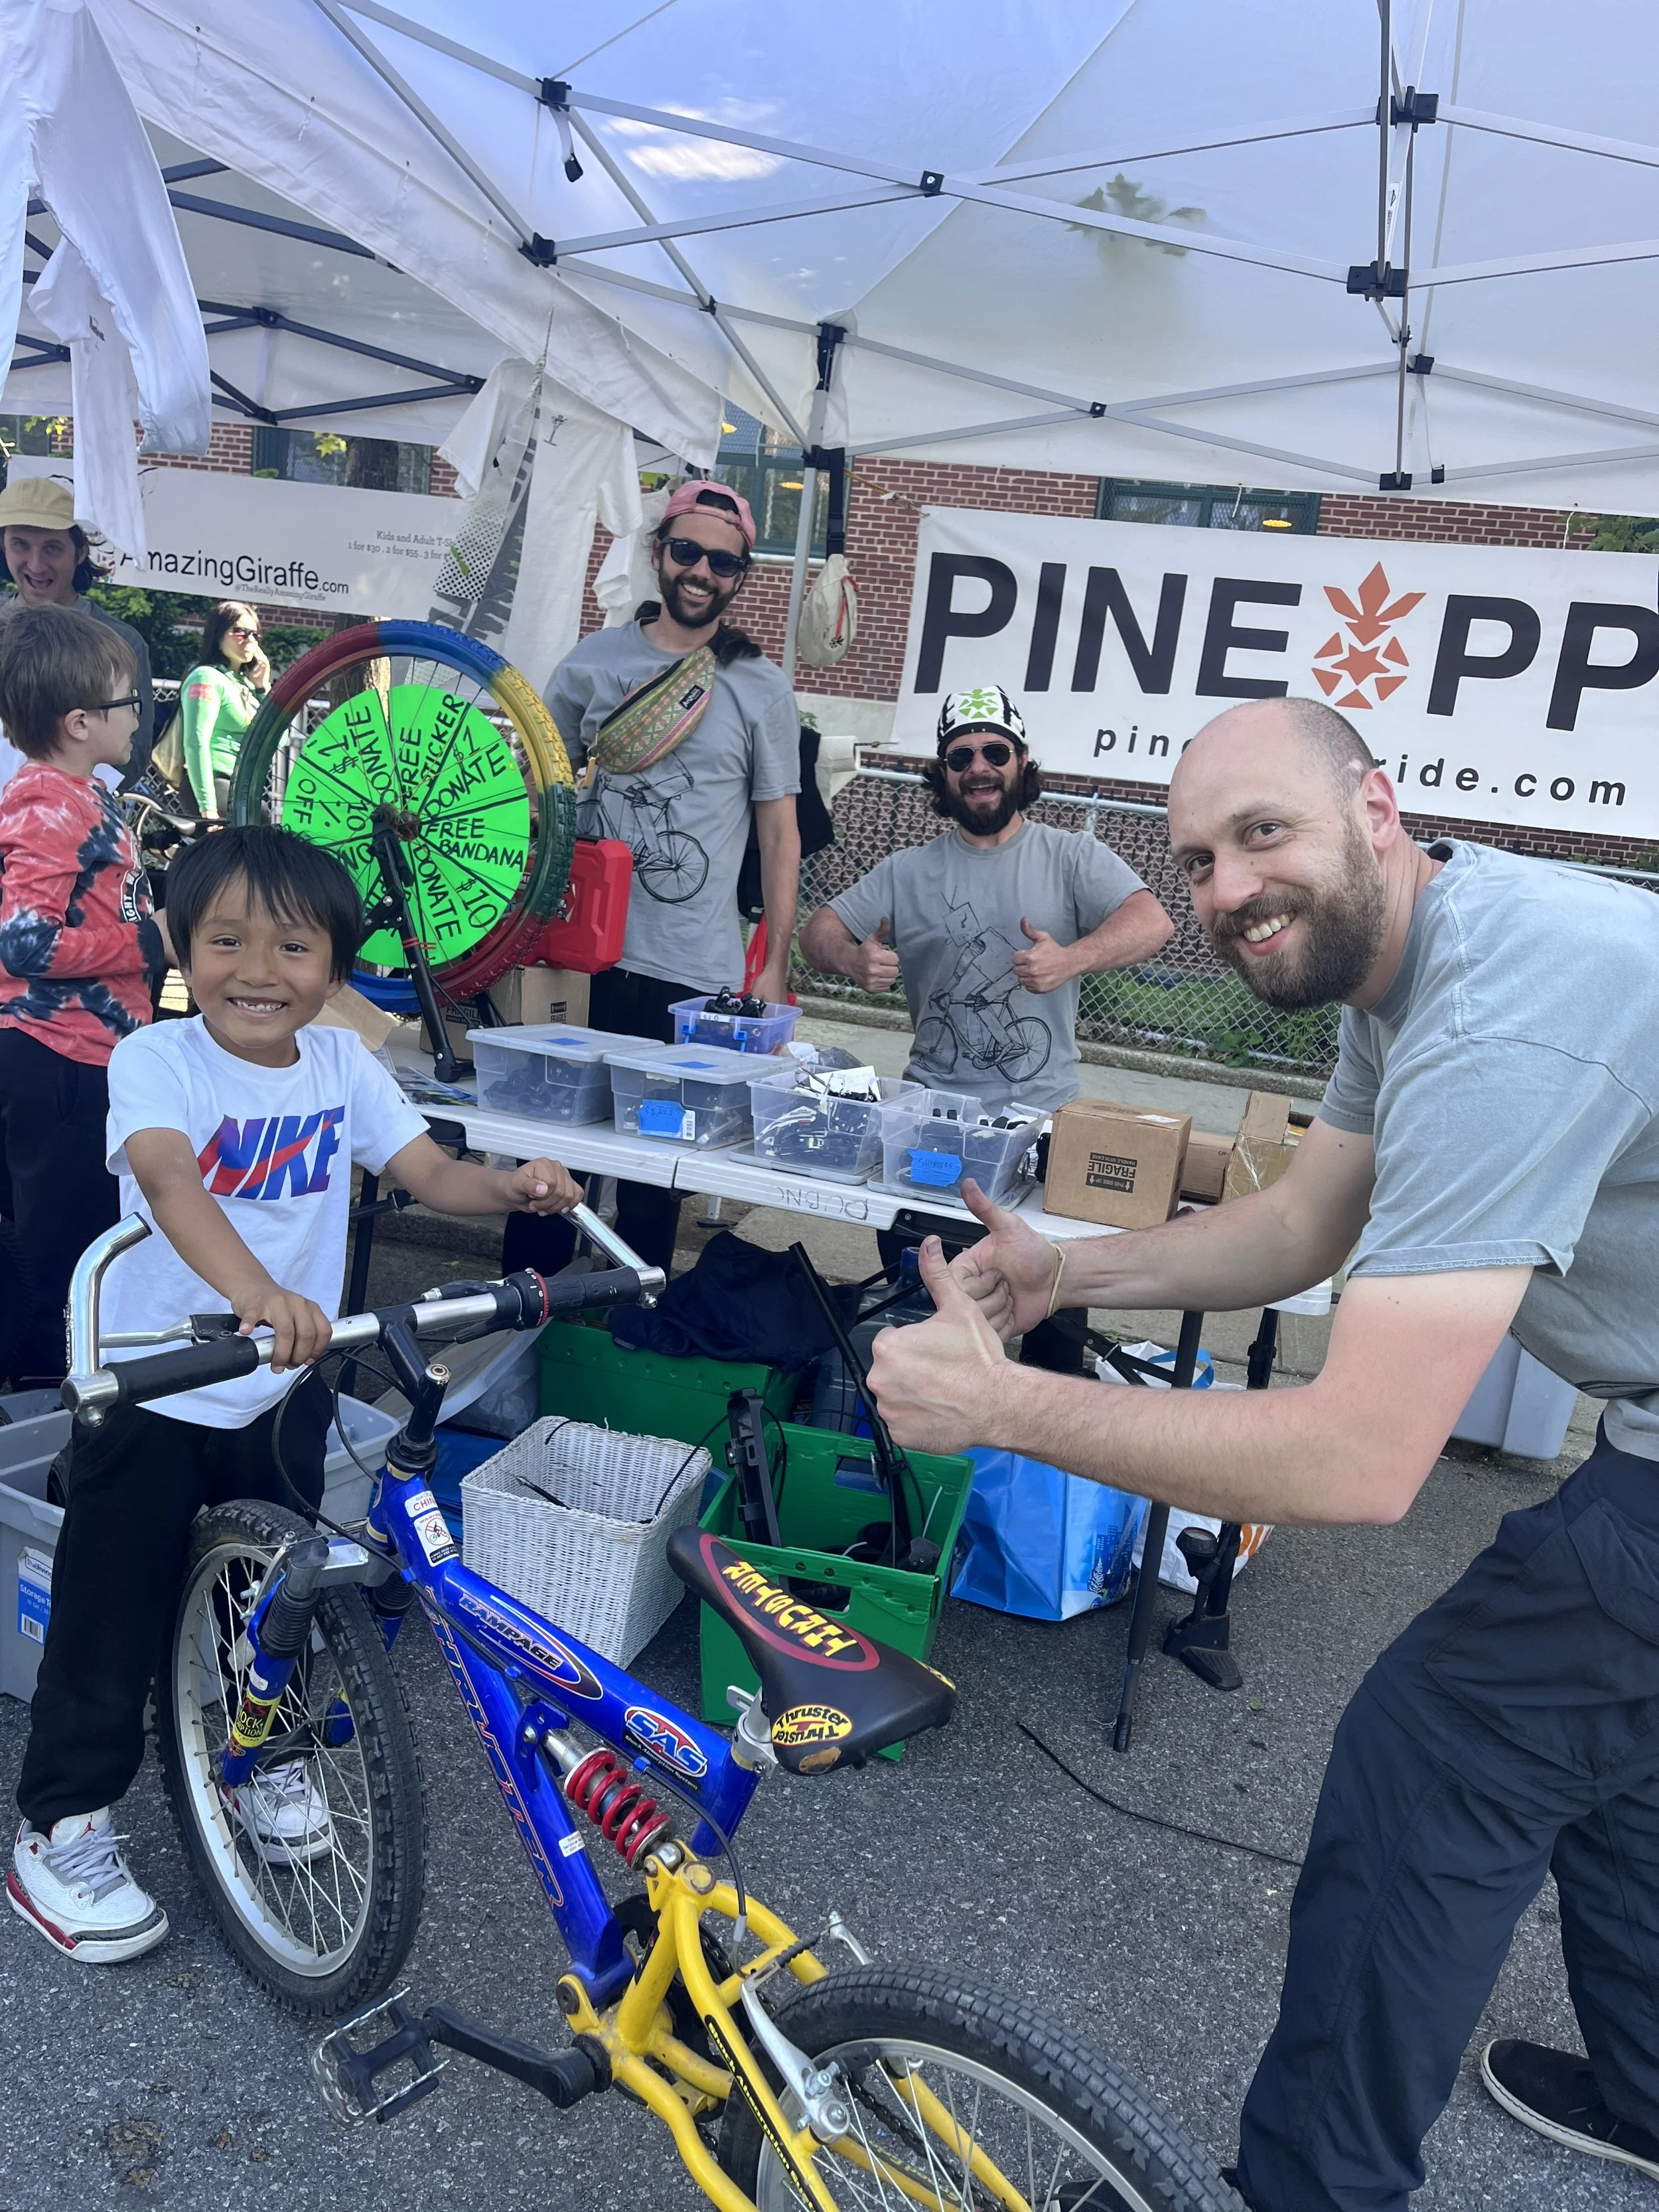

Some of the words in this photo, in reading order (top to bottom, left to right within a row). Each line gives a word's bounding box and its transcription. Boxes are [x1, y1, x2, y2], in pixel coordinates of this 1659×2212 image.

[354, 541, 364, 551] for
[392, 546, 403, 555] for
[405, 548, 418, 558] $55
[431, 550, 442, 559] for
[376, 531, 394, 541] Kids
[396, 534, 411, 543] and
[413, 535, 435, 546] Adult
[912, 552, 1303, 700] PINE
[345, 705, 398, 804] DONATE
[399, 727, 422, 806] FREE
[420, 694, 465, 788] STICKER
[1094, 725, 1193, 758] pin
[293, 778, 317, 825] OFF
[424, 743, 506, 818] DONATE
[424, 817, 485, 839] FREE
[439, 839, 524, 873] BANDANA
[413, 844, 463, 941] DONATE
[196, 1105, 345, 1201] NIKE
[1088, 1161, 1136, 1179] FRAGILE
[20, 1584, 46, 1603] Storage
[459, 1593, 563, 1670] RAMPAGE
[626, 1711, 708, 1774] SAS
[774, 1725, 839, 1743] Thruster
[776, 1707, 849, 1729] Thruster
[624, 1735, 642, 1750] Shock
[642, 1747, 675, 1773] Absorption
[675, 1771, 698, 1790] System
[708, 2022, 736, 2073] Shock
[736, 2075, 790, 2170] Absorption
